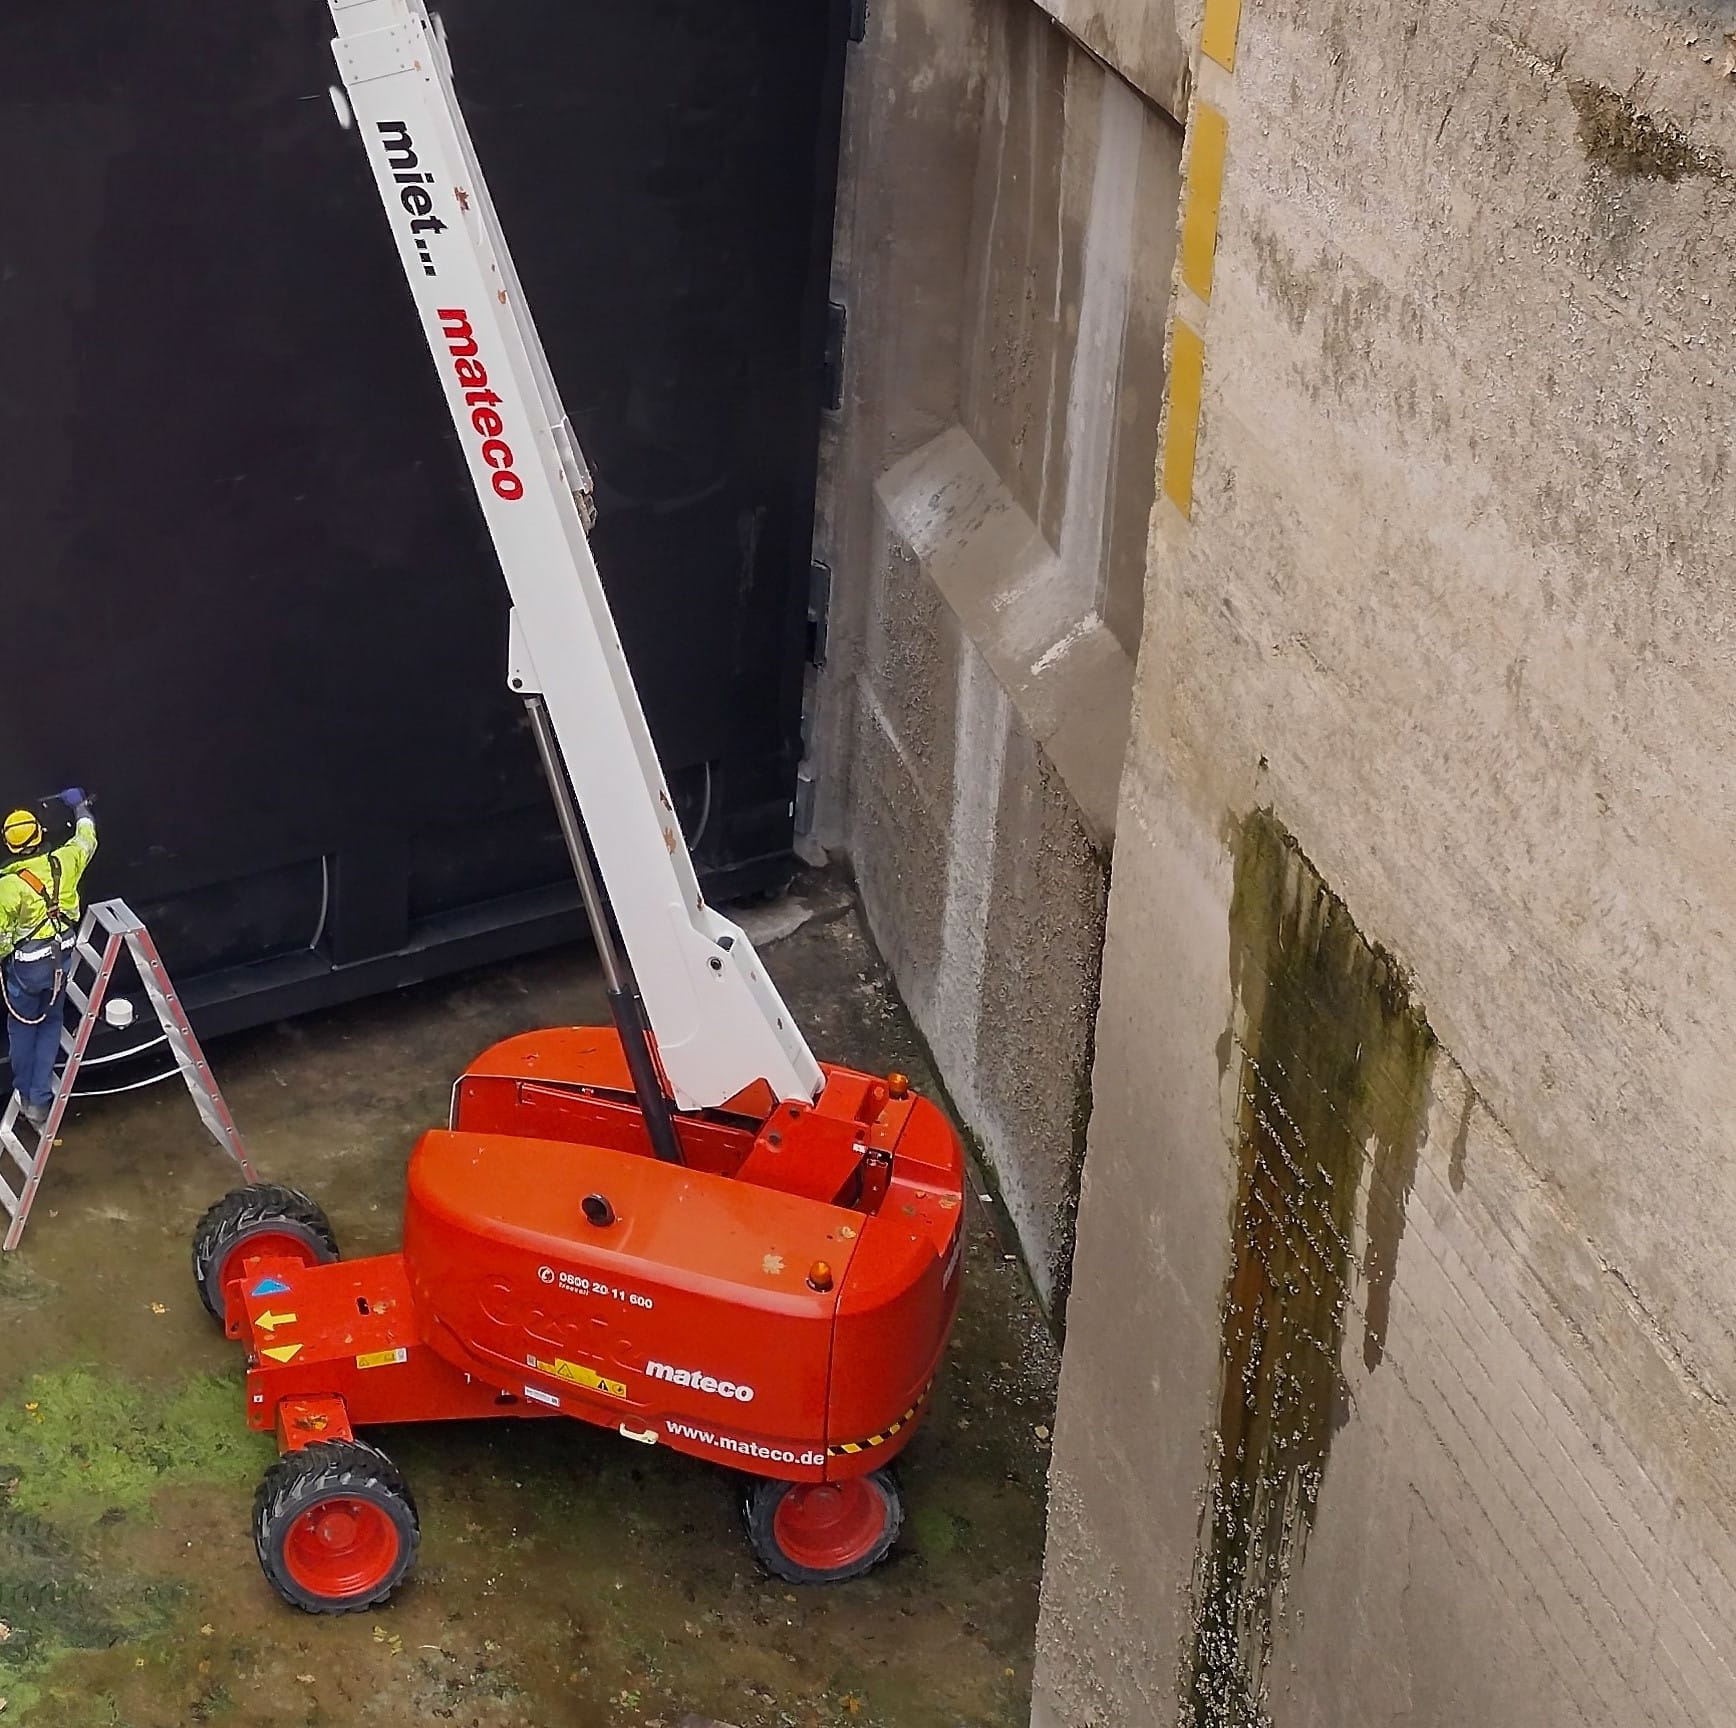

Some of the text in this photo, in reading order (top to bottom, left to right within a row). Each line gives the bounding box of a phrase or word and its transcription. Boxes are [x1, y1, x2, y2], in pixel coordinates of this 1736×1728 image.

[375, 119, 448, 277] miet...
[435, 308, 524, 501] mateco
[558, 1271, 653, 1309] 0800 20 11 600
[645, 1360, 755, 1402] mateco
[665, 1420, 825, 1466] www.mateco.de
